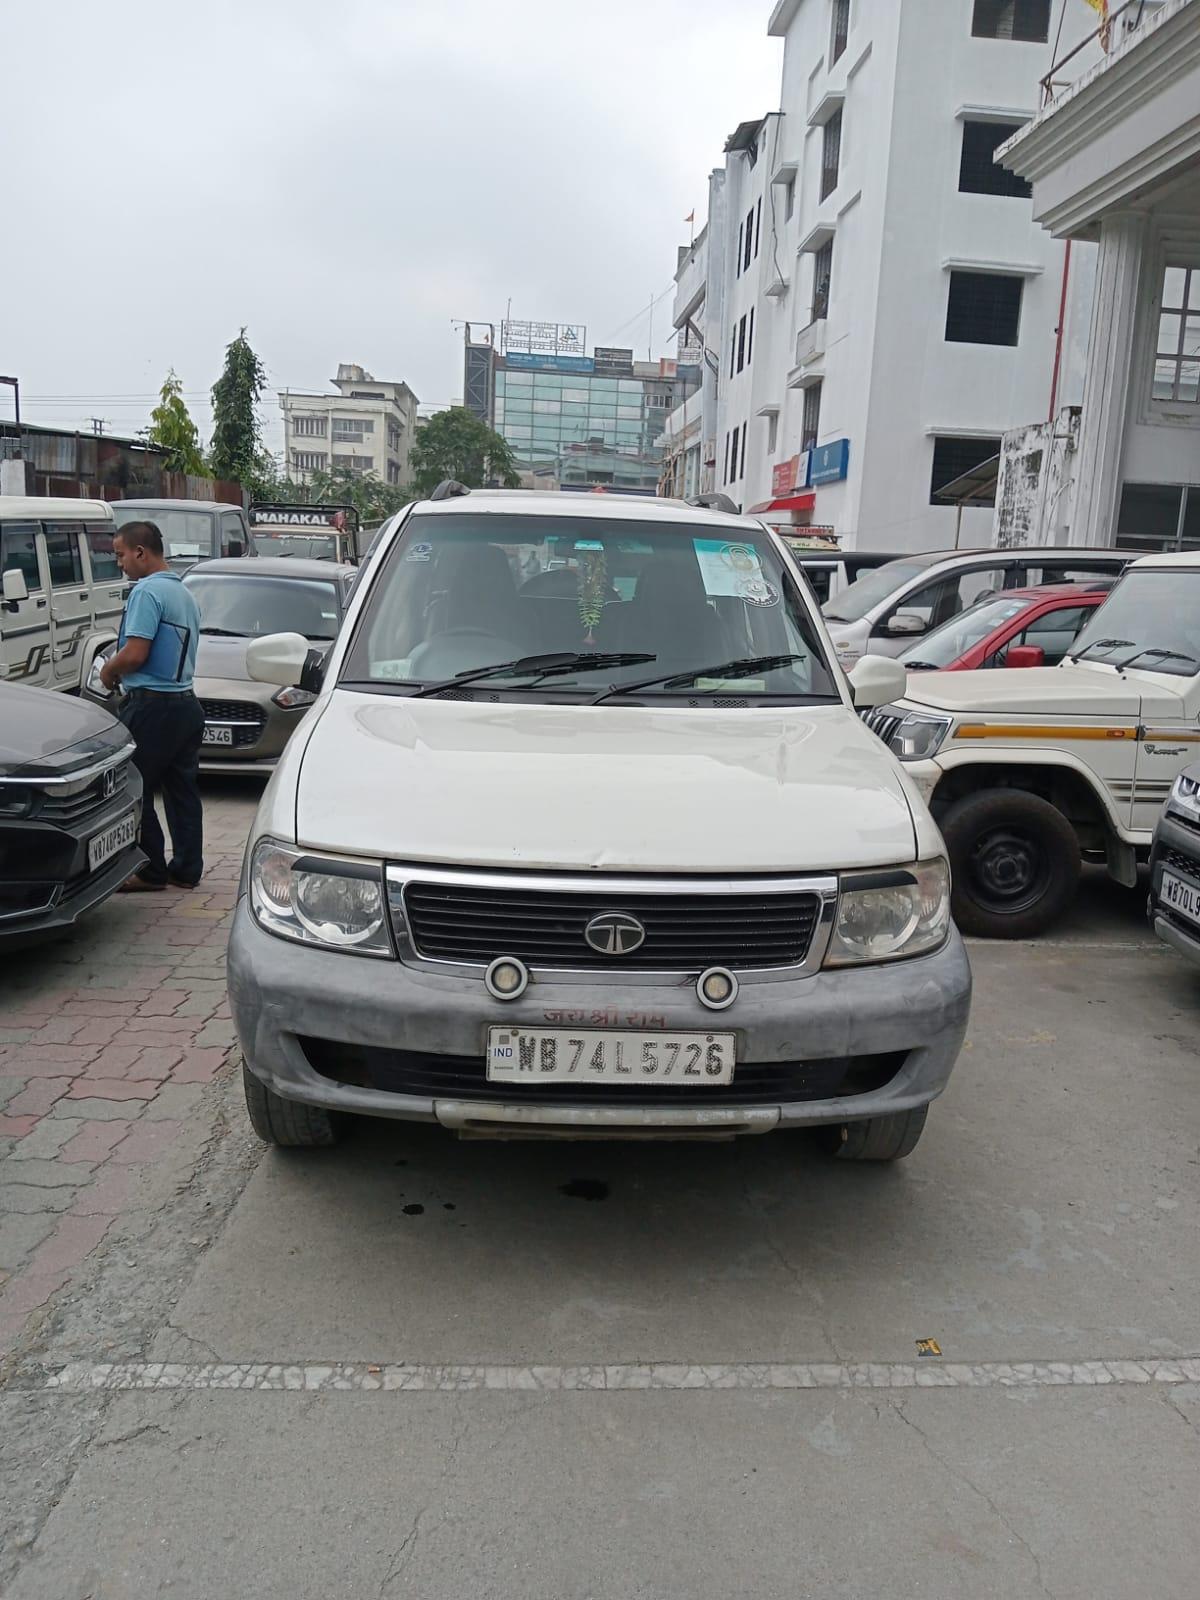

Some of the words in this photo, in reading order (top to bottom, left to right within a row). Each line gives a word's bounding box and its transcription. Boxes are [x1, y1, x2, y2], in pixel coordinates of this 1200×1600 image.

[255, 512, 330, 526] MAHAKAL
[201, 729, 230, 743] 2546
[493, 1047, 513, 1058] IND
